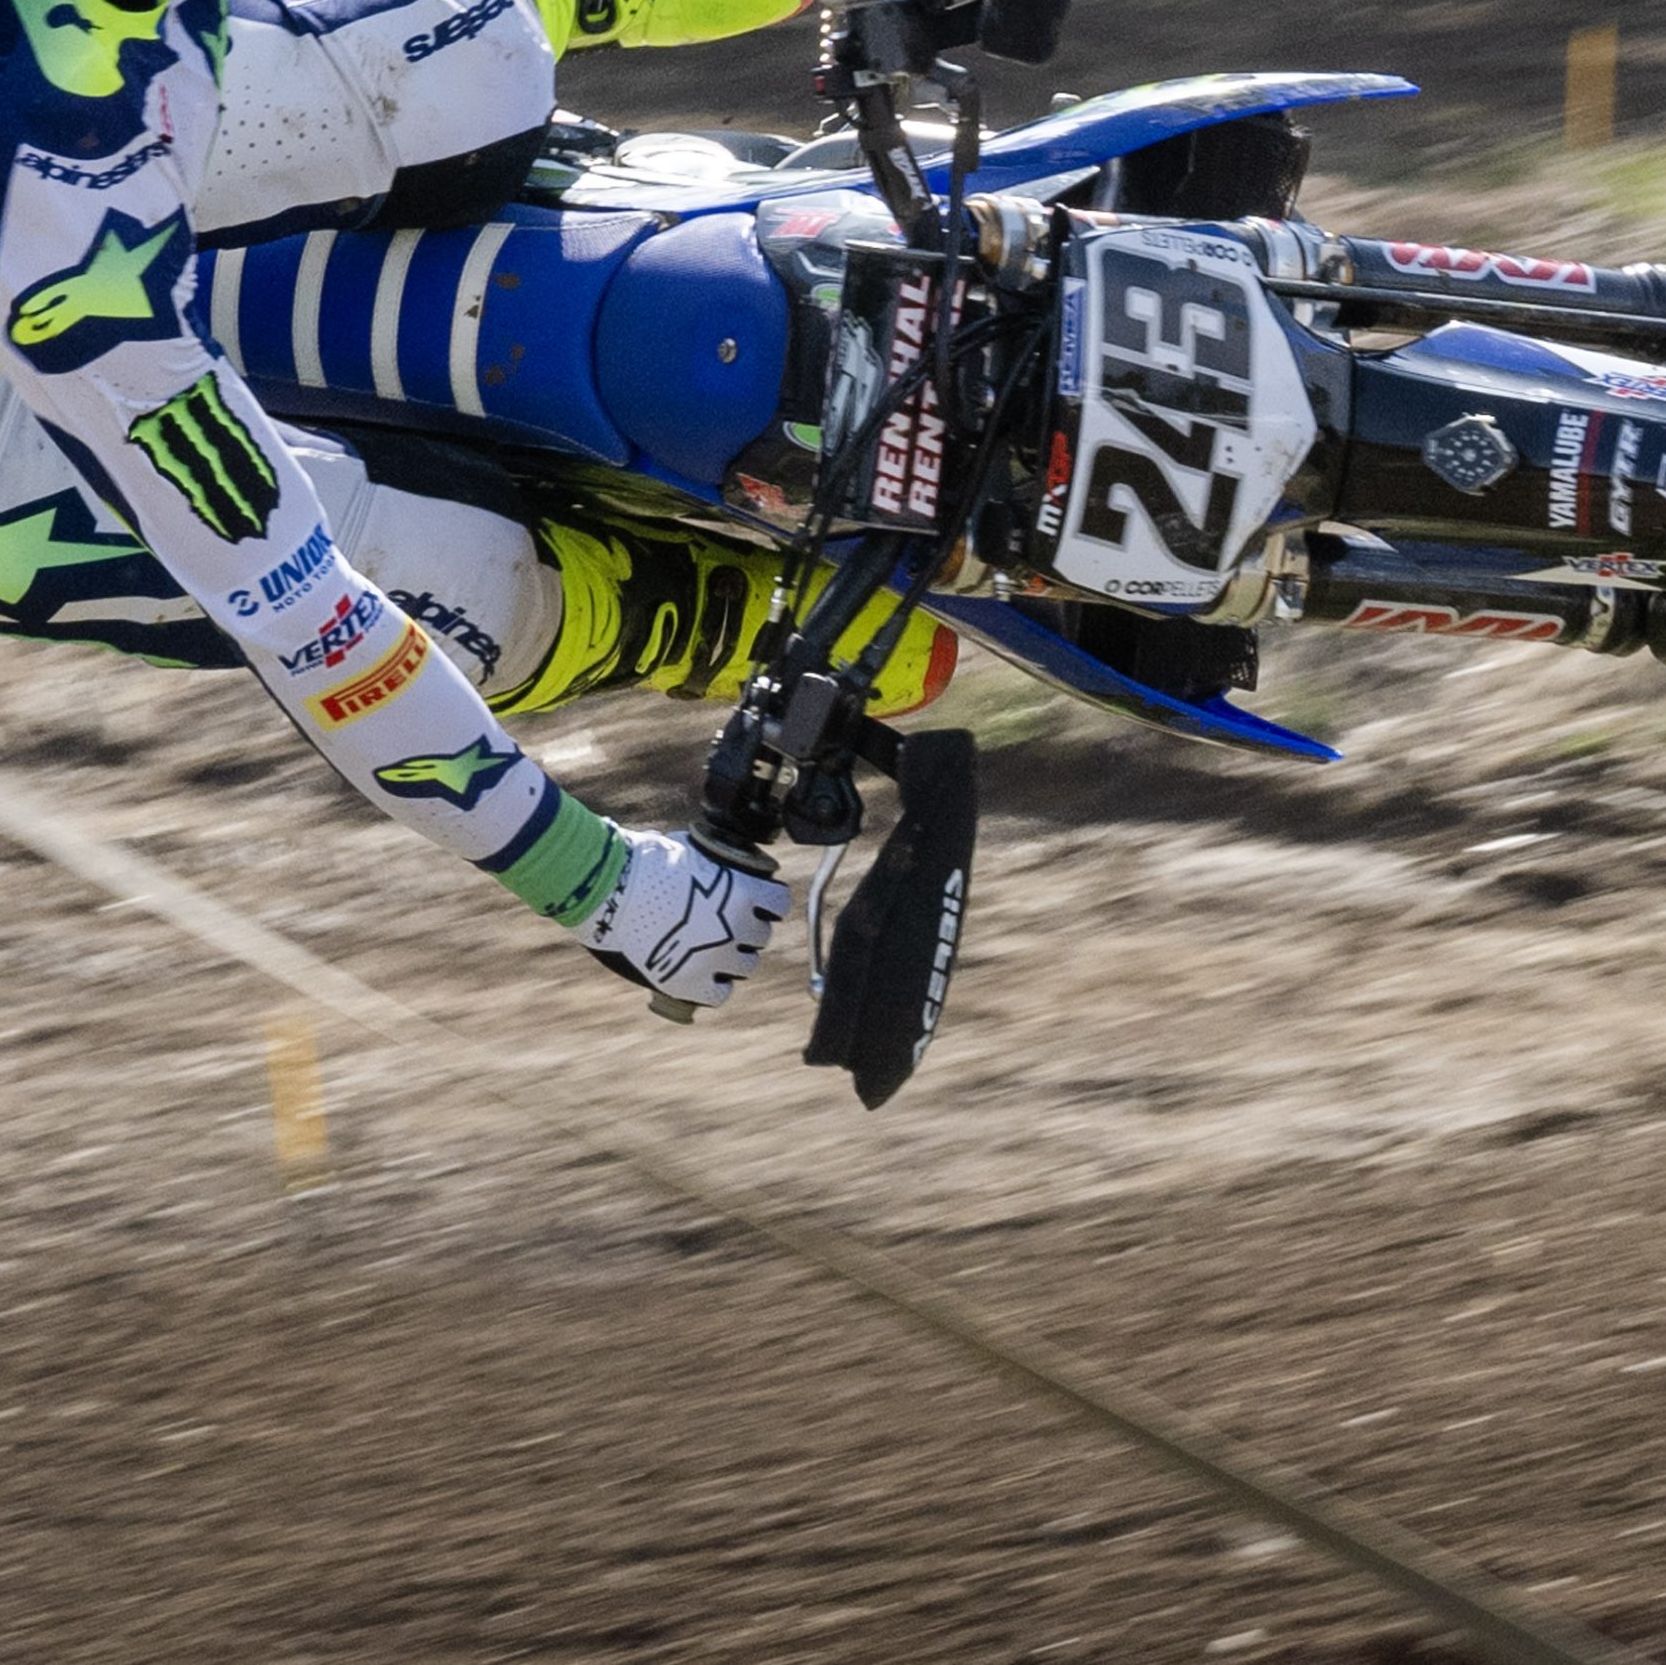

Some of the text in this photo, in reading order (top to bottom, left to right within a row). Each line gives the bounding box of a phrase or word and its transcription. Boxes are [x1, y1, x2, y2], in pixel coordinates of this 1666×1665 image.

[1073, 247, 1254, 574] 243
[1548, 411, 1589, 529] YAMALUBE
[1608, 418, 1643, 537] GYTR
[272, 582, 313, 613] MOTO
[278, 590, 379, 670] VERTEX
